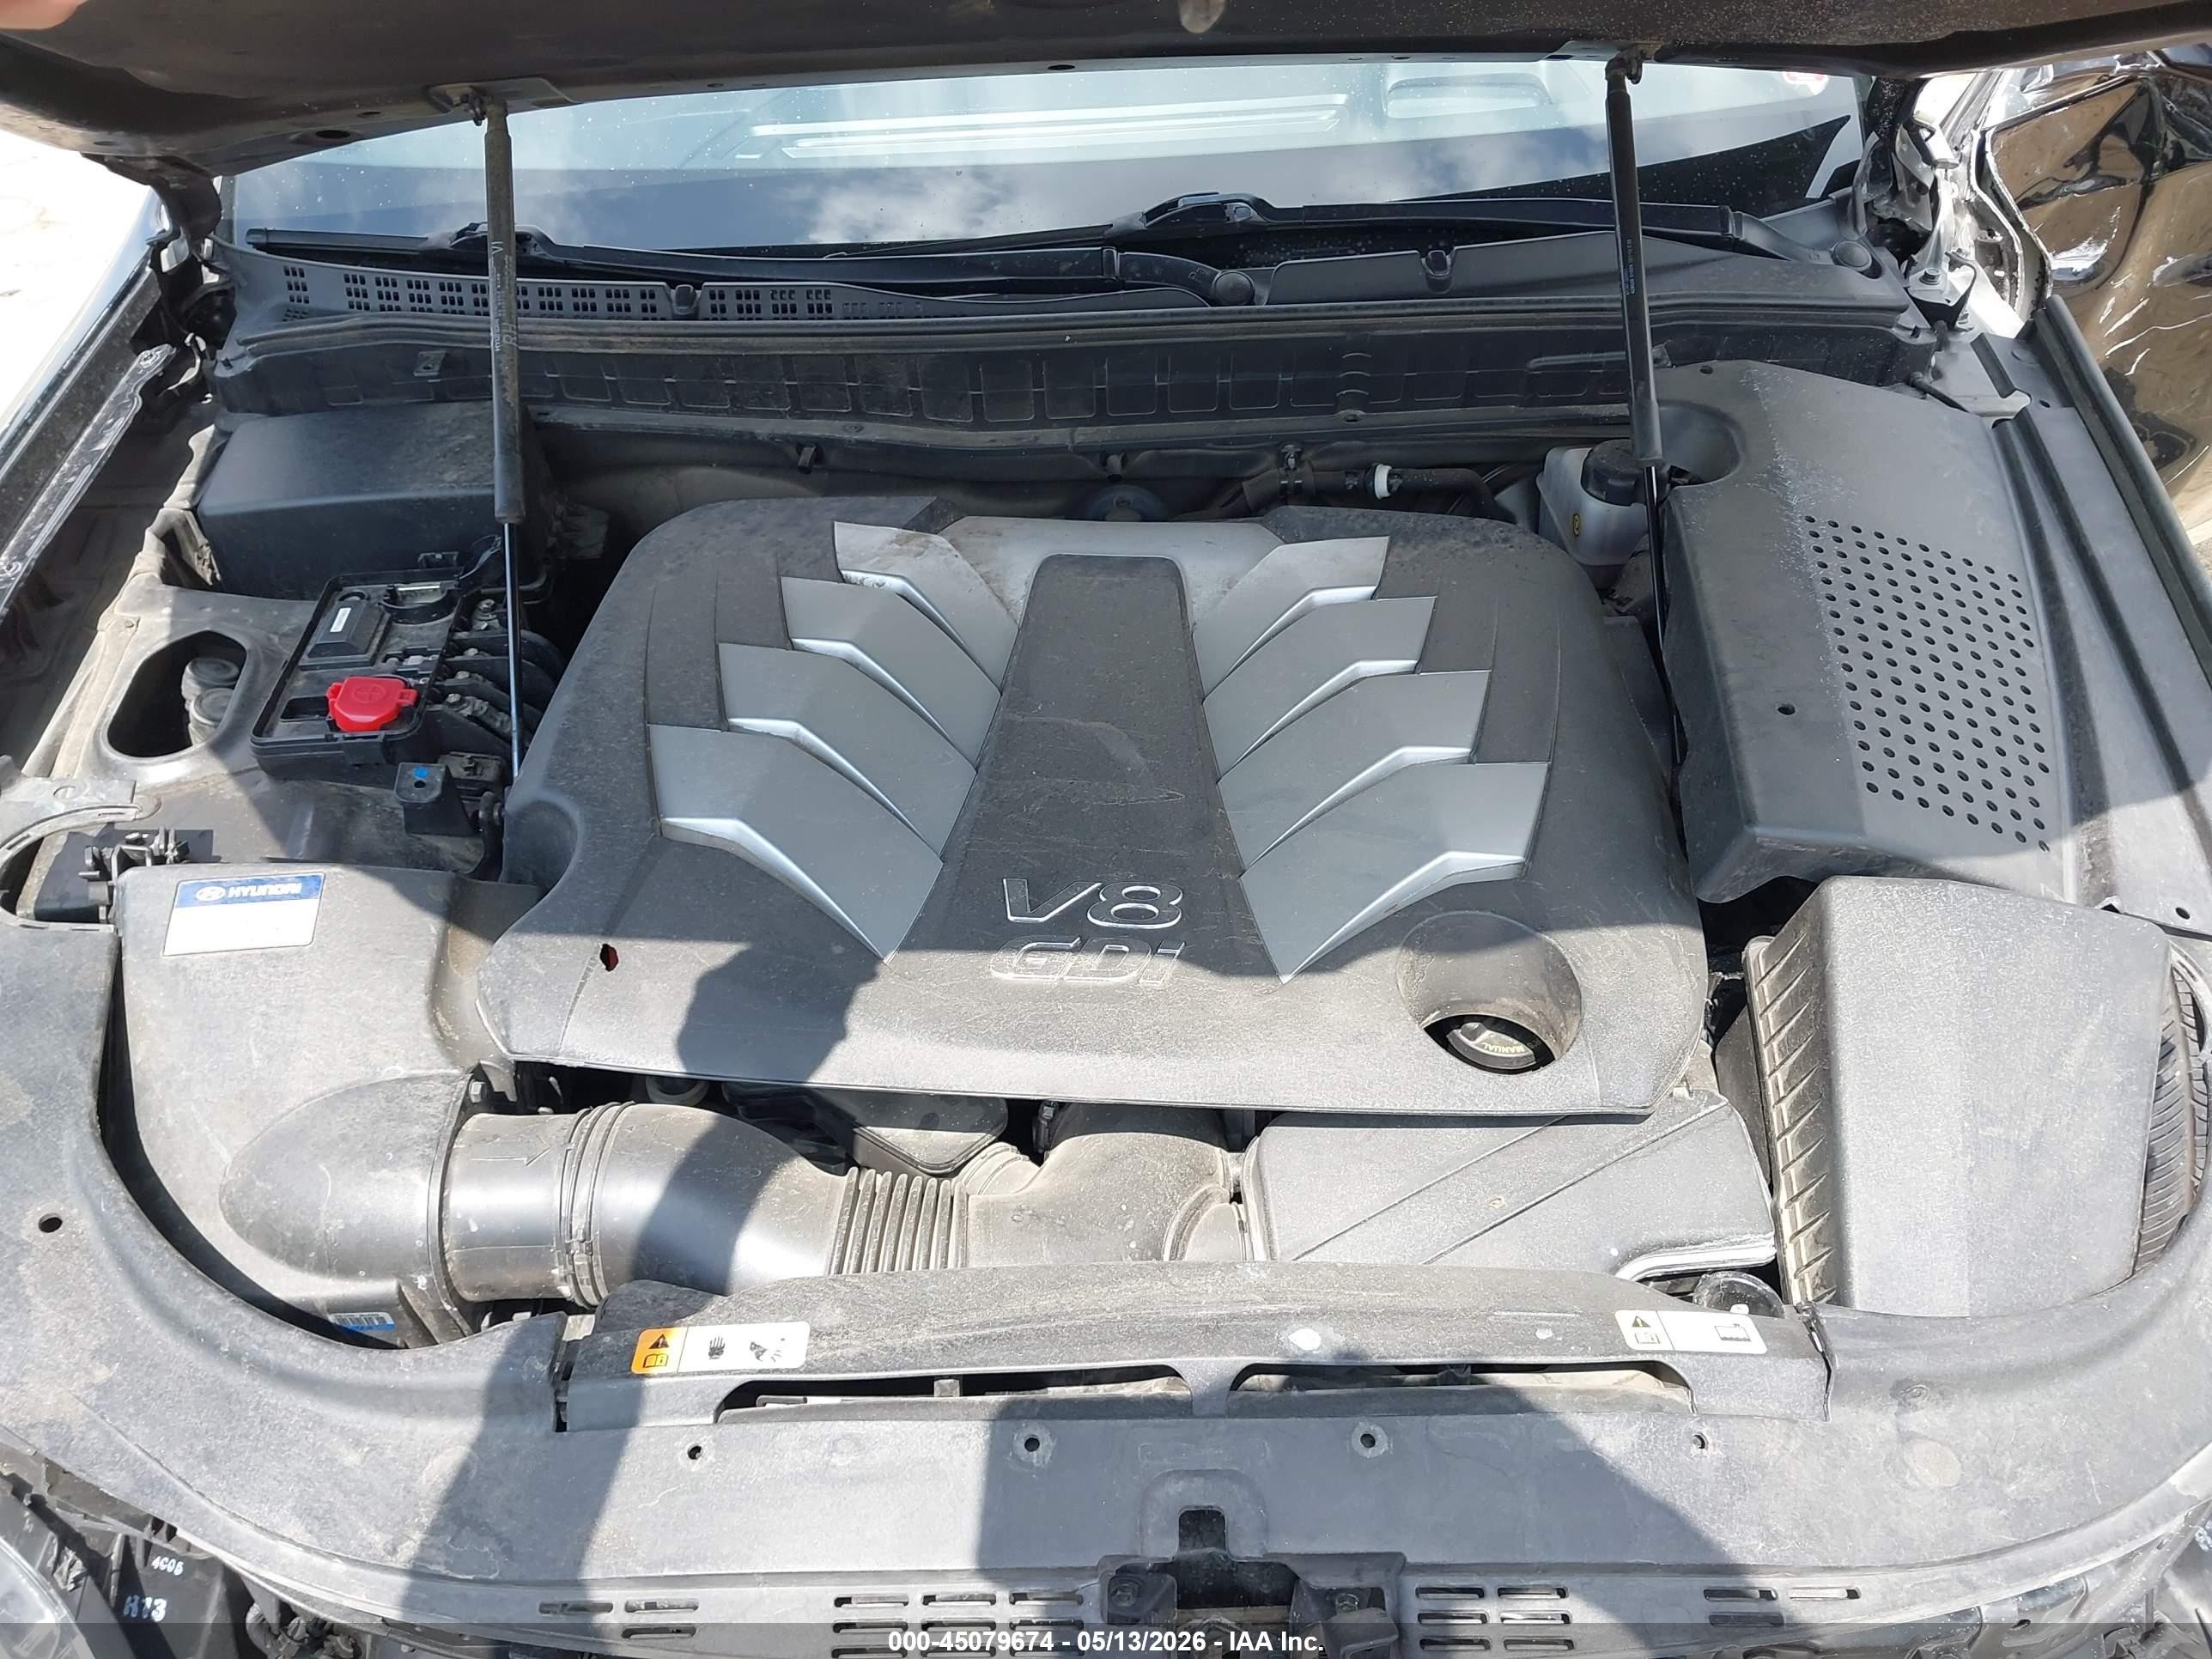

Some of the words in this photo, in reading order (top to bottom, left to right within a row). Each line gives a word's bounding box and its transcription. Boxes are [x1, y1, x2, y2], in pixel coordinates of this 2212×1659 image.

[501, 323, 517, 347] RH
[228, 883, 302, 898] HYUNDAI
[1002, 878, 1183, 929] V8
[1481, 1042, 1525, 1054] MANUAL
